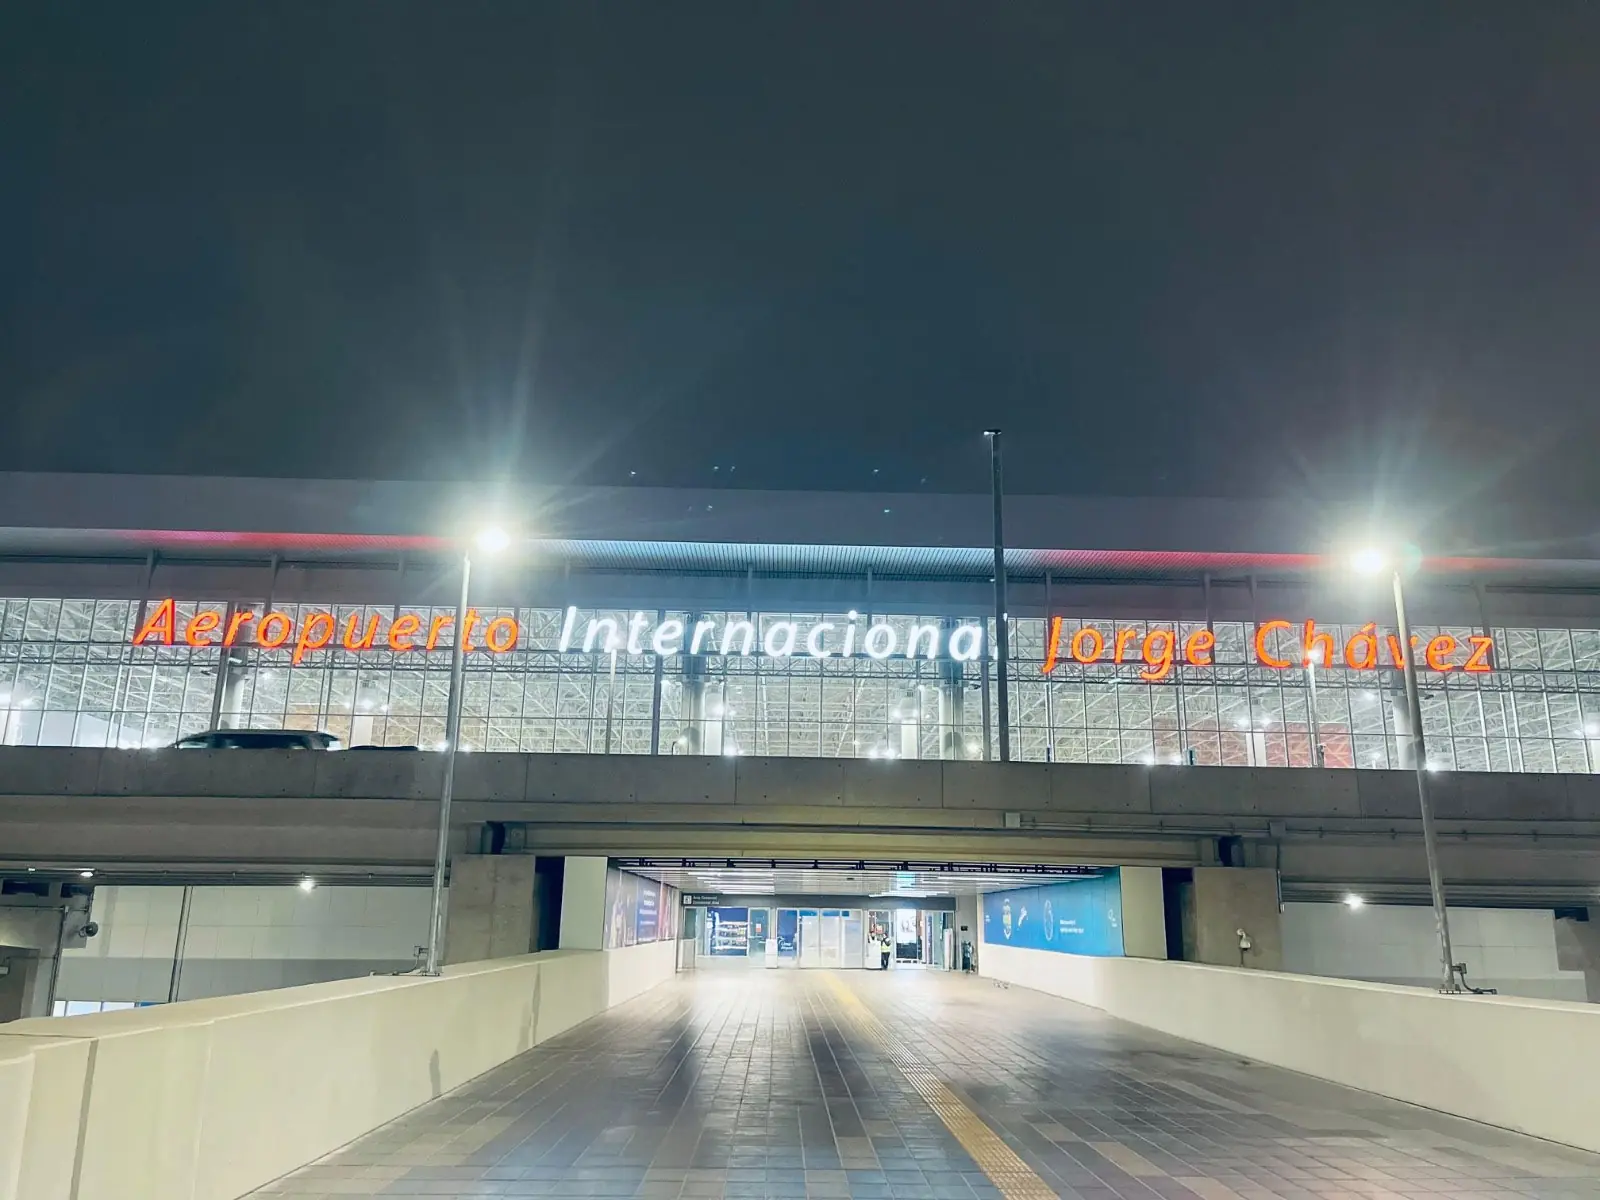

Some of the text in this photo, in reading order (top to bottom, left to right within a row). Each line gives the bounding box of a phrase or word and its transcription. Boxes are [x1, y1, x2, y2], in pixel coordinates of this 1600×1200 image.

[132, 597, 1495, 683] Aeropuerto Internaciona Jorge Chávez
